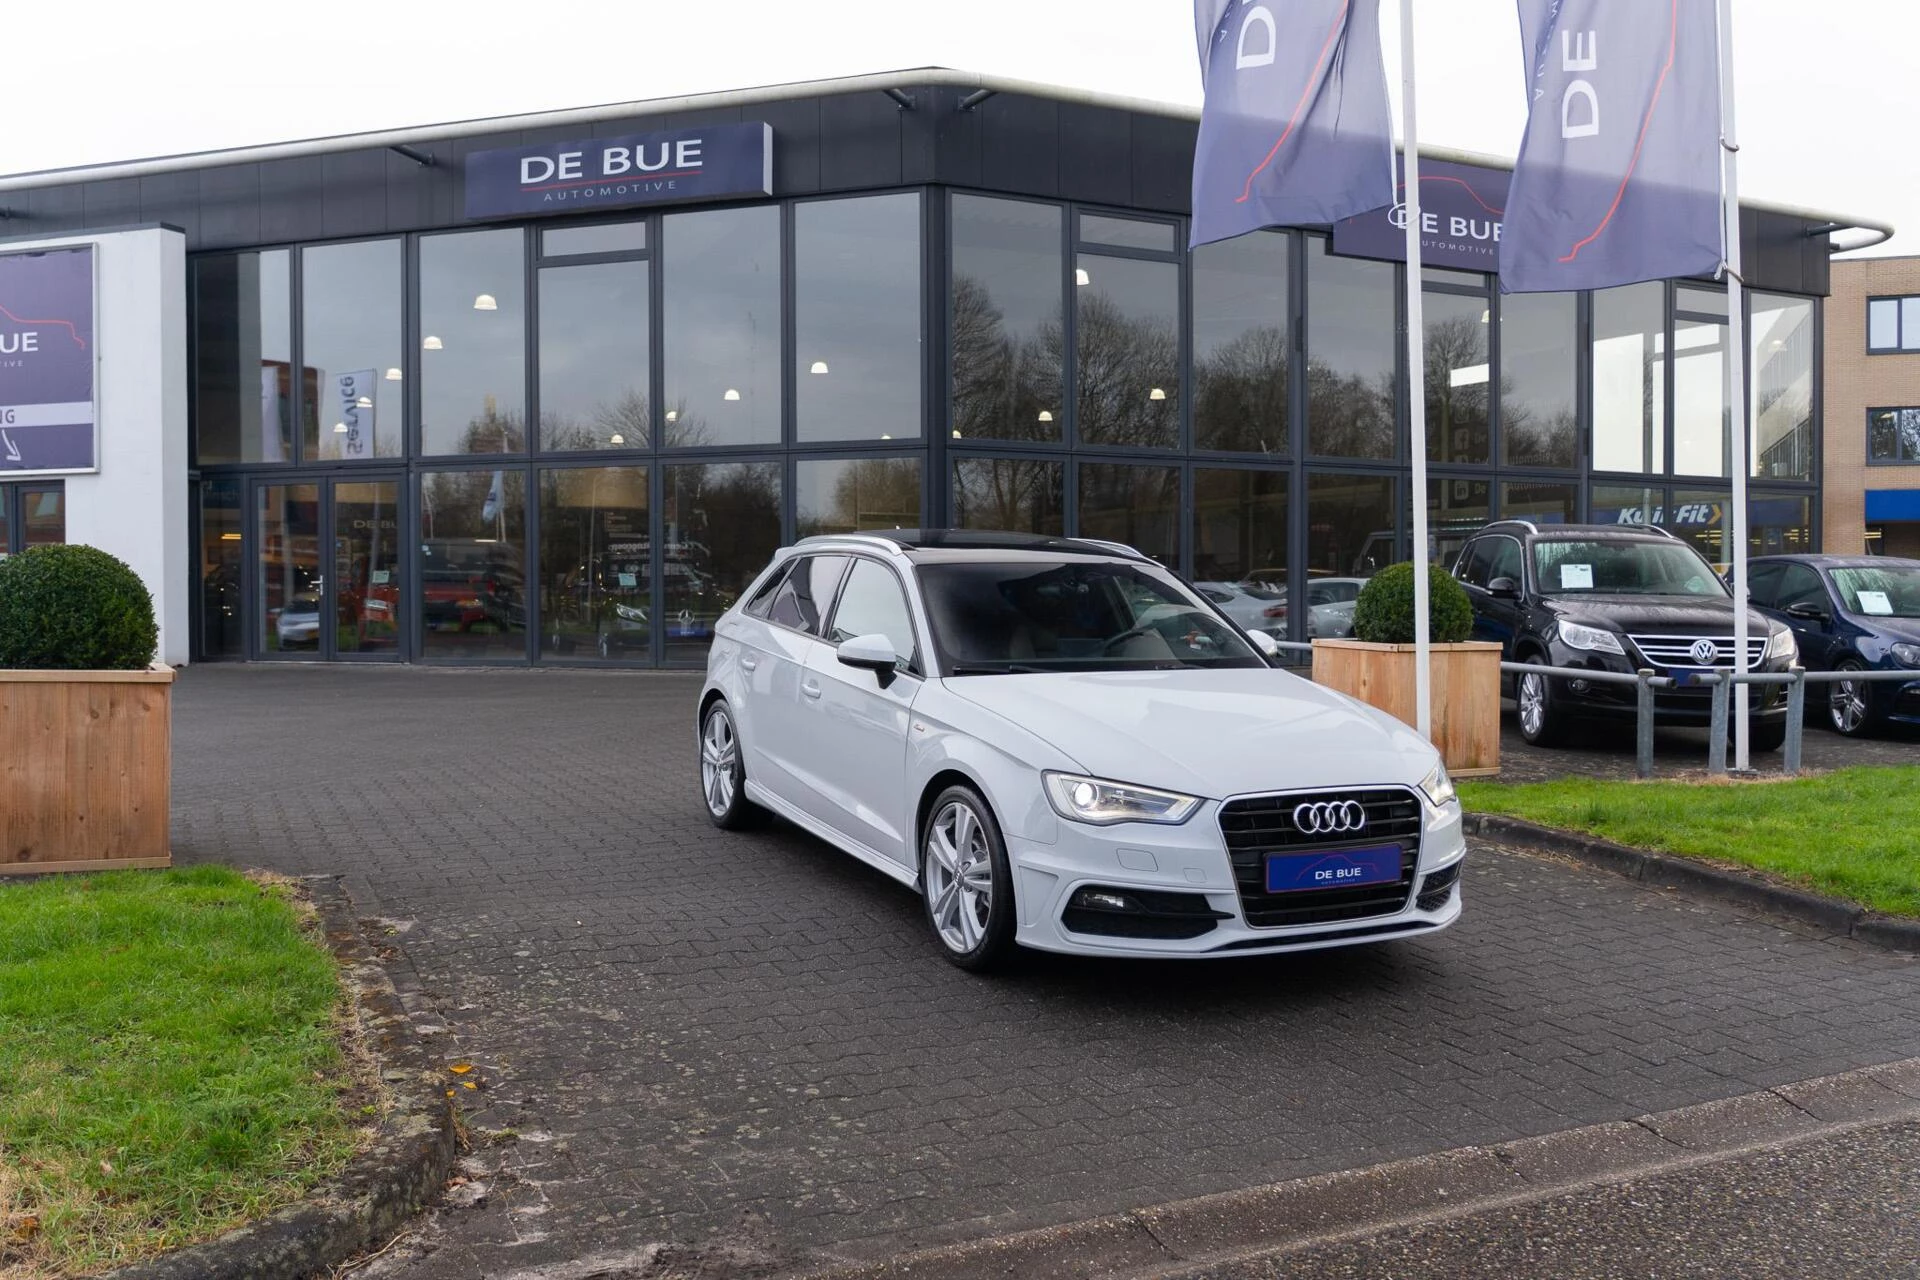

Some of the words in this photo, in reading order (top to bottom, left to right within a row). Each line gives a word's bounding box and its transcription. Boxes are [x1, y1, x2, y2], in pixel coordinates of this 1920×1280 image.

[1562, 30, 1599, 139] DE
[521, 151, 583, 184] DE
[603, 139, 703, 175] BUE
[543, 180, 677, 202] AUTOMOTIVE
[1421, 240, 1494, 256] UTOMOTIVE
[1676, 503, 1709, 523] Fit
[1315, 870, 1332, 880] DE
[1337, 867, 1361, 878] BUE
